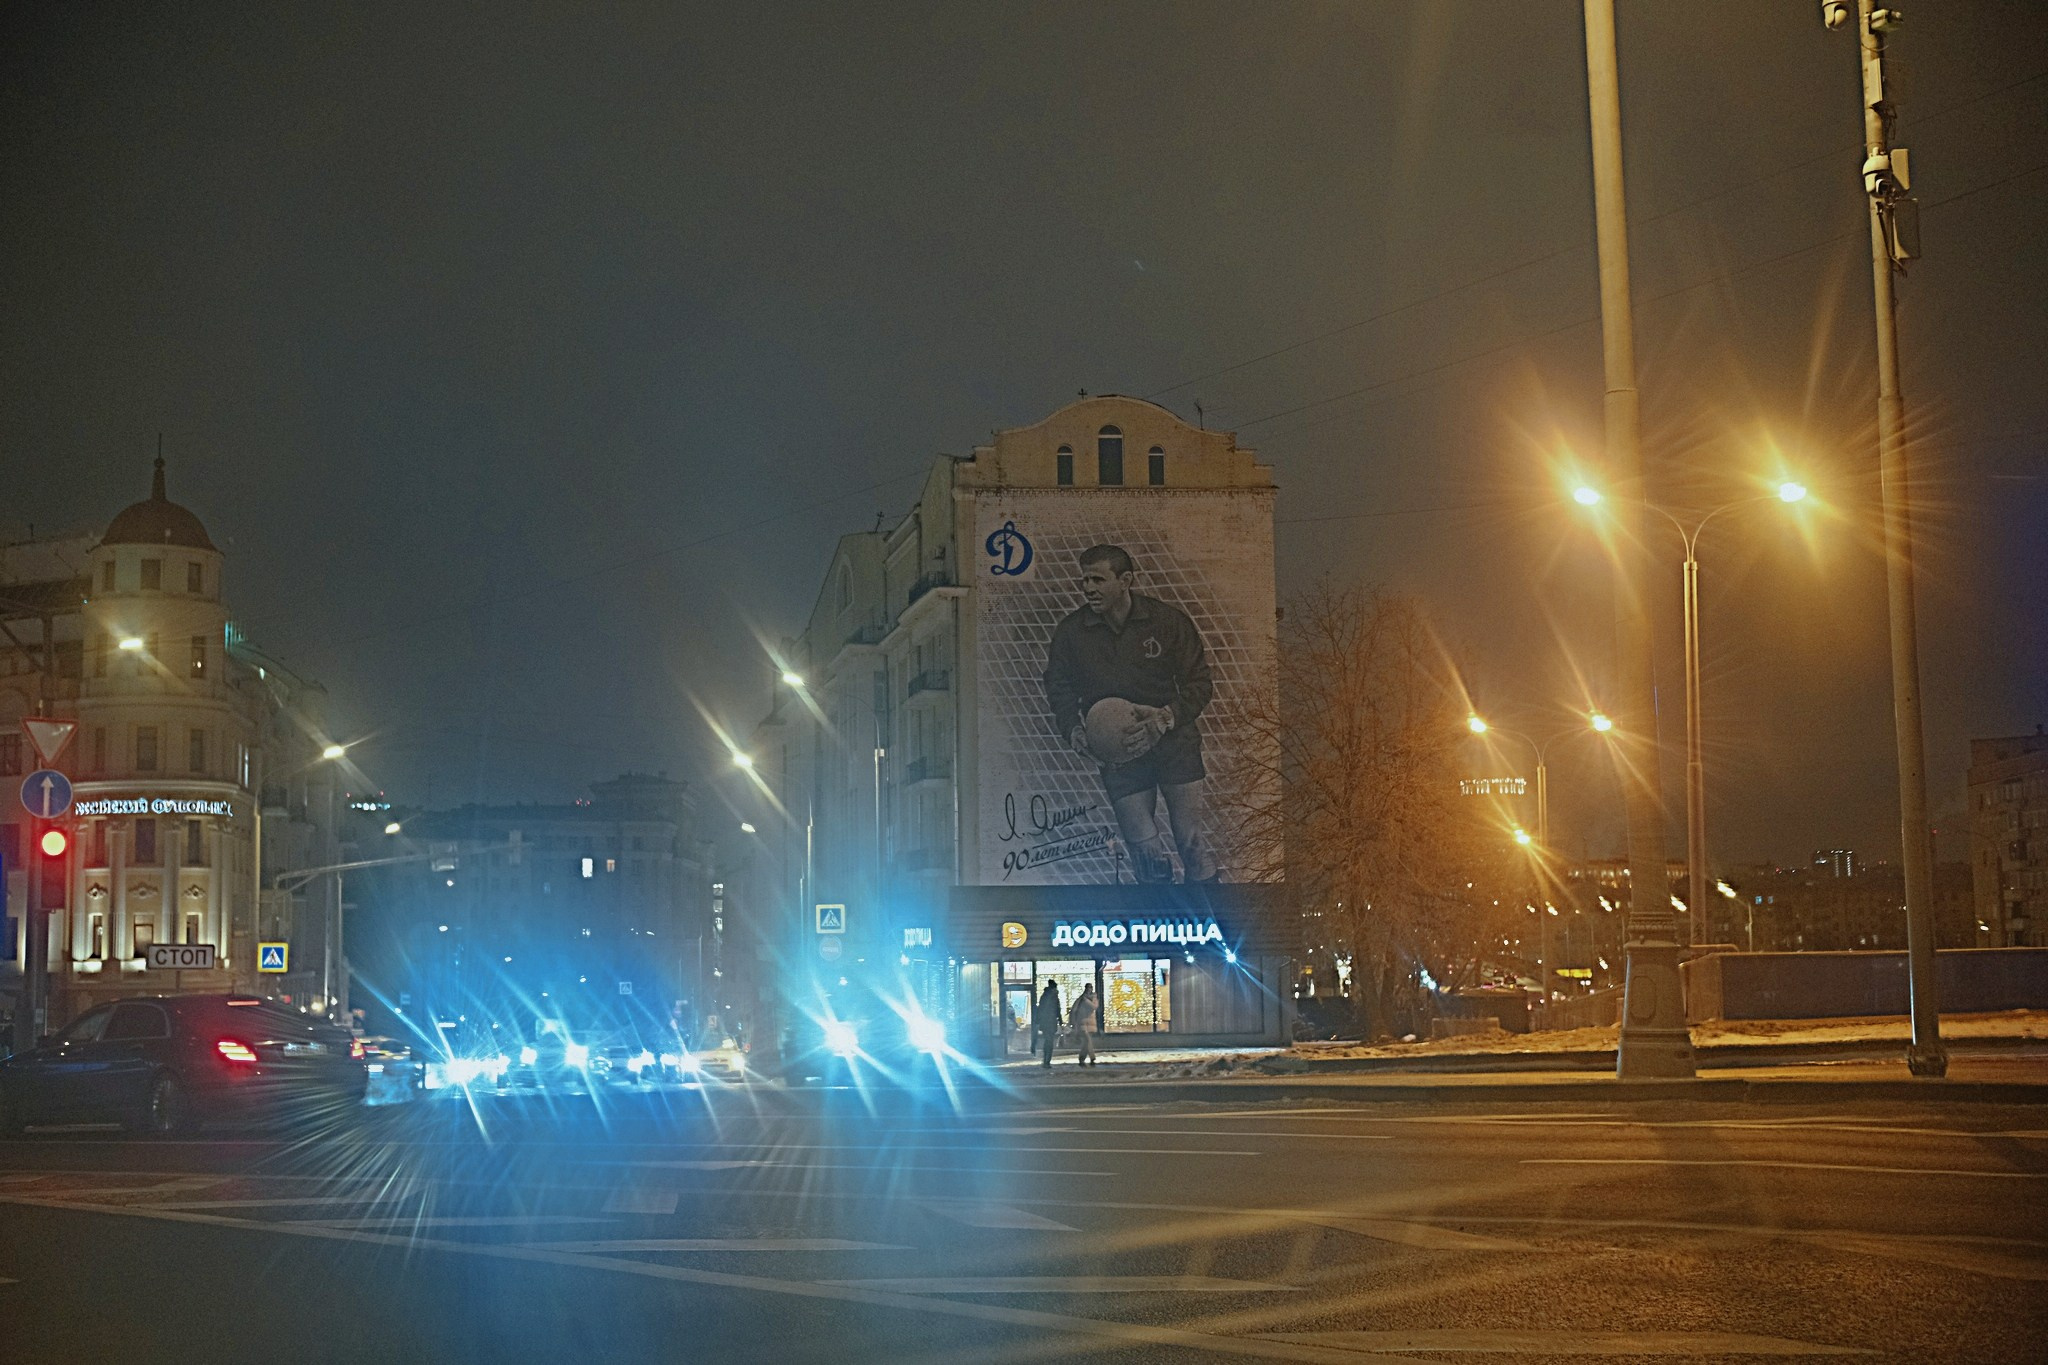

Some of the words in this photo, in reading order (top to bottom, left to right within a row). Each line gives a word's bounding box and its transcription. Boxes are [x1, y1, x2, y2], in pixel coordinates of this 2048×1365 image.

[1003, 849, 1030, 881] 90
[1052, 925, 1128, 947] ДОДО
[1131, 923, 1223, 946] ПИЦЦА
[155, 949, 207, 965] СТОП
